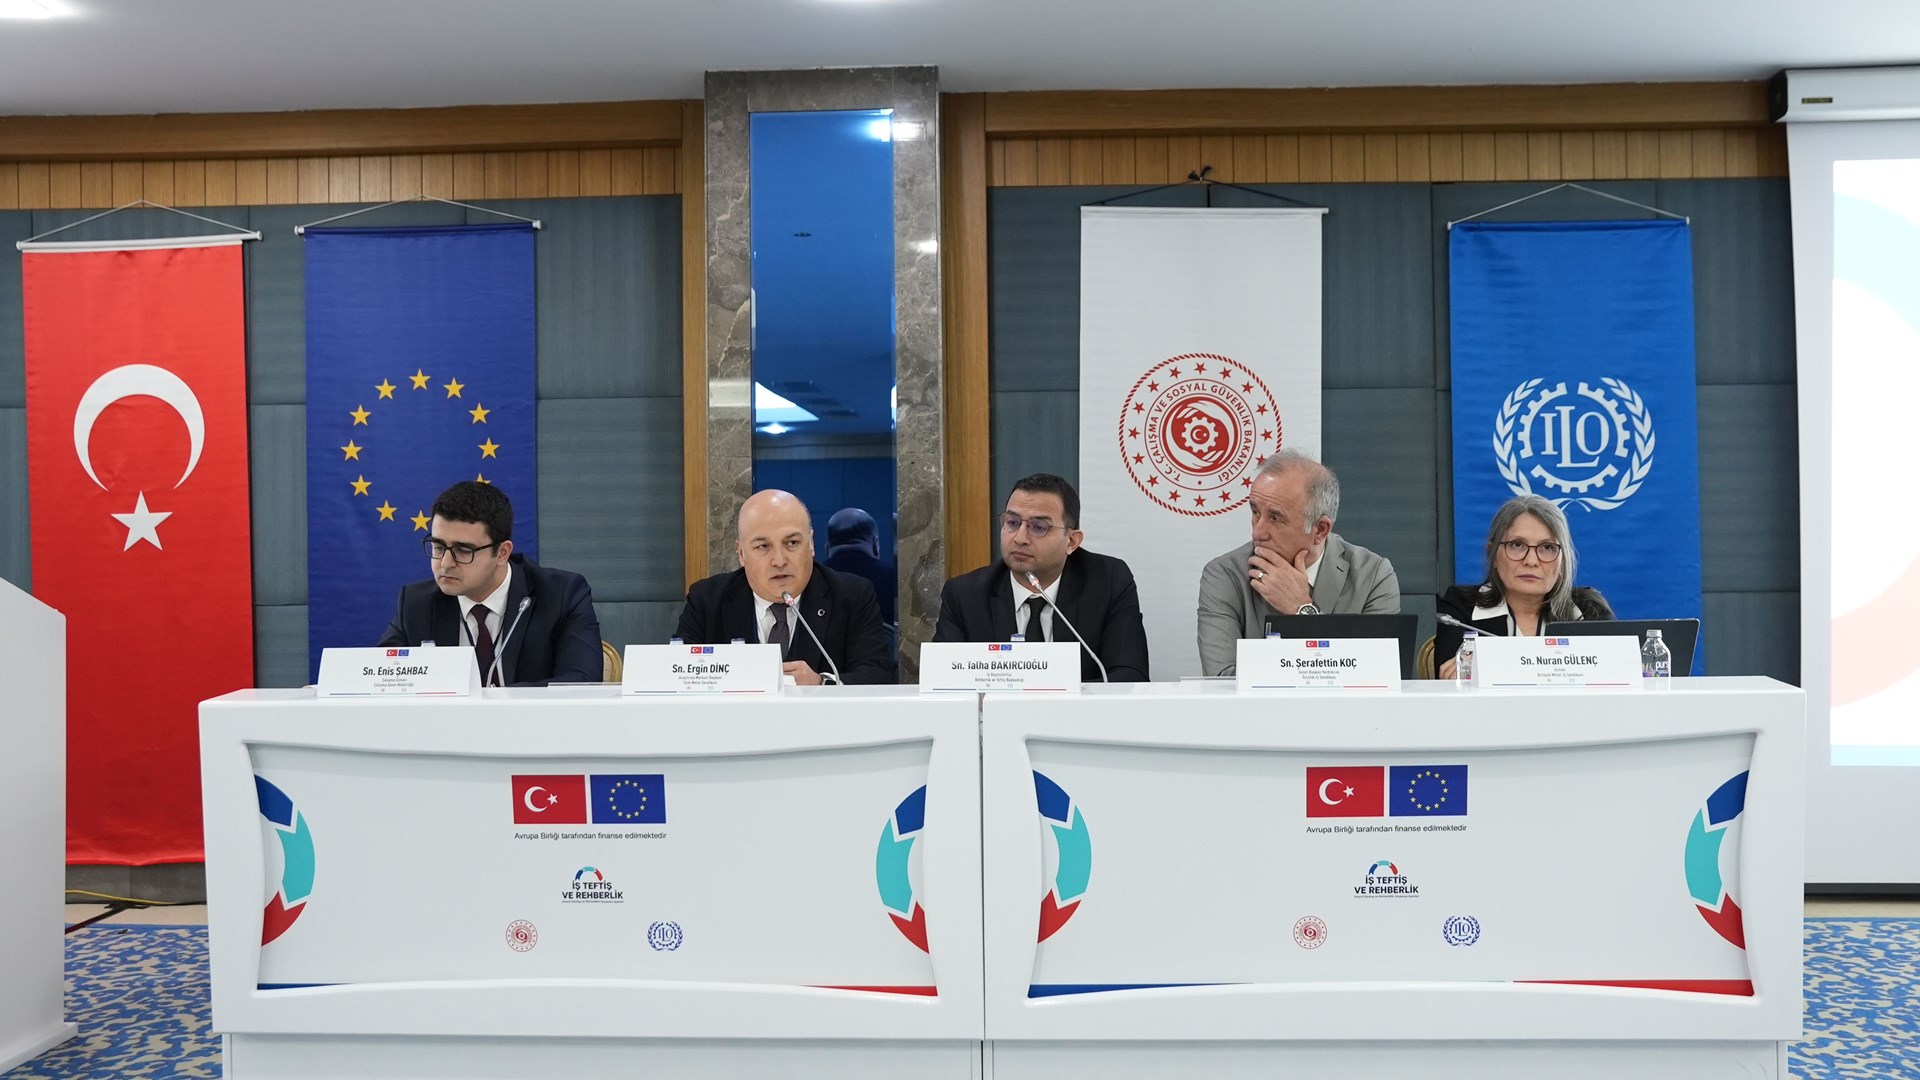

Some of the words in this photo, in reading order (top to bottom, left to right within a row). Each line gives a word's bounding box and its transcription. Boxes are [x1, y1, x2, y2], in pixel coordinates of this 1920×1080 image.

[1167, 383, 1207, 402] SOSYAL
[1154, 401, 1167, 413] VE
[1211, 384, 1252, 426] GÜVENLİK
[1149, 416, 1164, 464] ÇALIŞMA
[1540, 406, 1610, 468] ILO
[1218, 430, 1252, 482] BAKANLIĞI
[1165, 464, 1181, 482] T.C.
[952, 661, 965, 670] Sn.
[968, 661, 989, 670] Talha
[991, 659, 1048, 670] BAKIRCIOĞLU
[1280, 658, 1294, 667] Sn.
[1296, 658, 1338, 670] Şerafettin
[1340, 658, 1357, 669] KOÇ
[1520, 656, 1534, 665] Sn.
[1536, 656, 1562, 665] Nuran
[1564, 654, 1598, 667] GÜLENÇ
[363, 666, 375, 675] Sn.
[378, 666, 394, 675] Enis
[396, 666, 428, 677] ŞAHBAZ
[672, 664, 685, 673] Sn.
[688, 664, 708, 675] Ergin
[710, 662, 730, 675] DİNÇ
[1334, 826, 1354, 834] Birliği
[541, 832, 560, 841] Birliği
[572, 880, 580, 891] İŞ
[583, 880, 612, 891] TEFTİŞ
[1366, 875, 1374, 885] İŞ
[1376, 875, 1407, 885] TEFTİŞ
[576, 890, 623, 899] REHBERLİK
[1369, 884, 1419, 894] REHBERLİK
[658, 928, 673, 942] ILO
[1454, 923, 1470, 936] ILO
